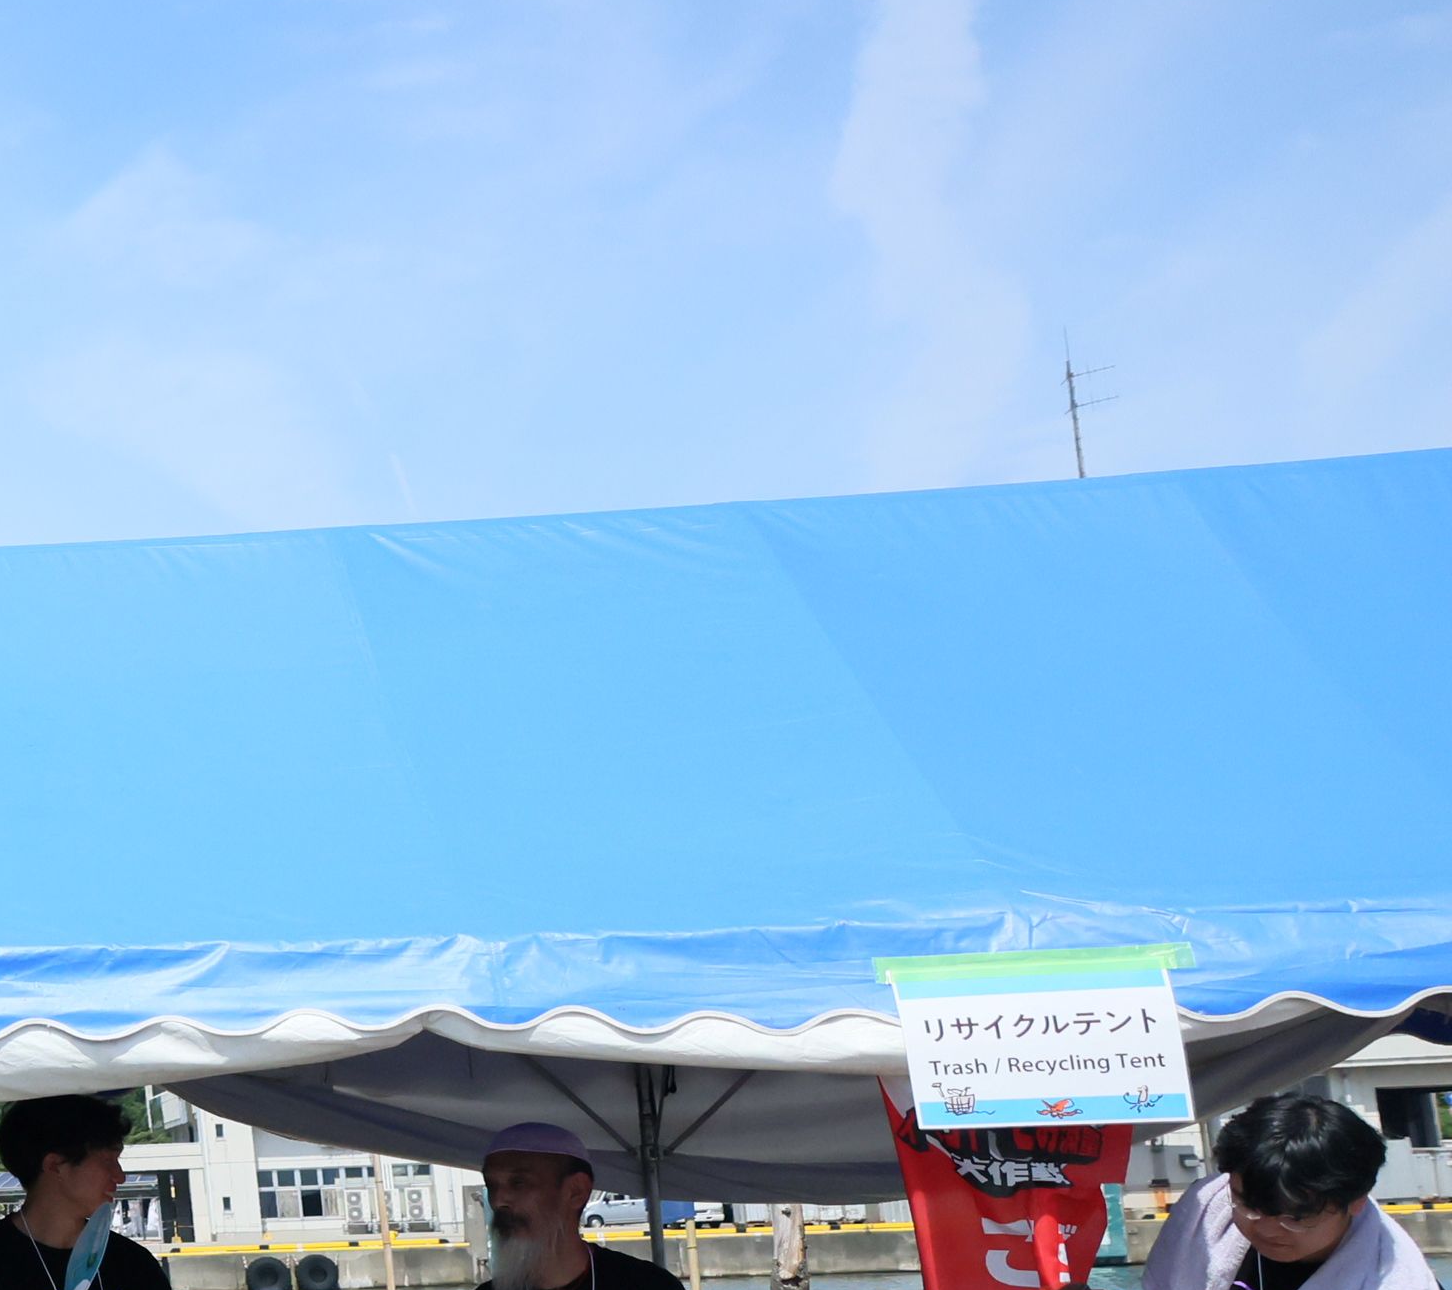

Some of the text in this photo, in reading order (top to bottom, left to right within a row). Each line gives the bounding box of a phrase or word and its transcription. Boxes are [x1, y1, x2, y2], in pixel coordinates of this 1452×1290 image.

[924, 1008, 1157, 1042] リサイクルテント
[929, 1053, 1166, 1076] Trash / Recycling Tent
